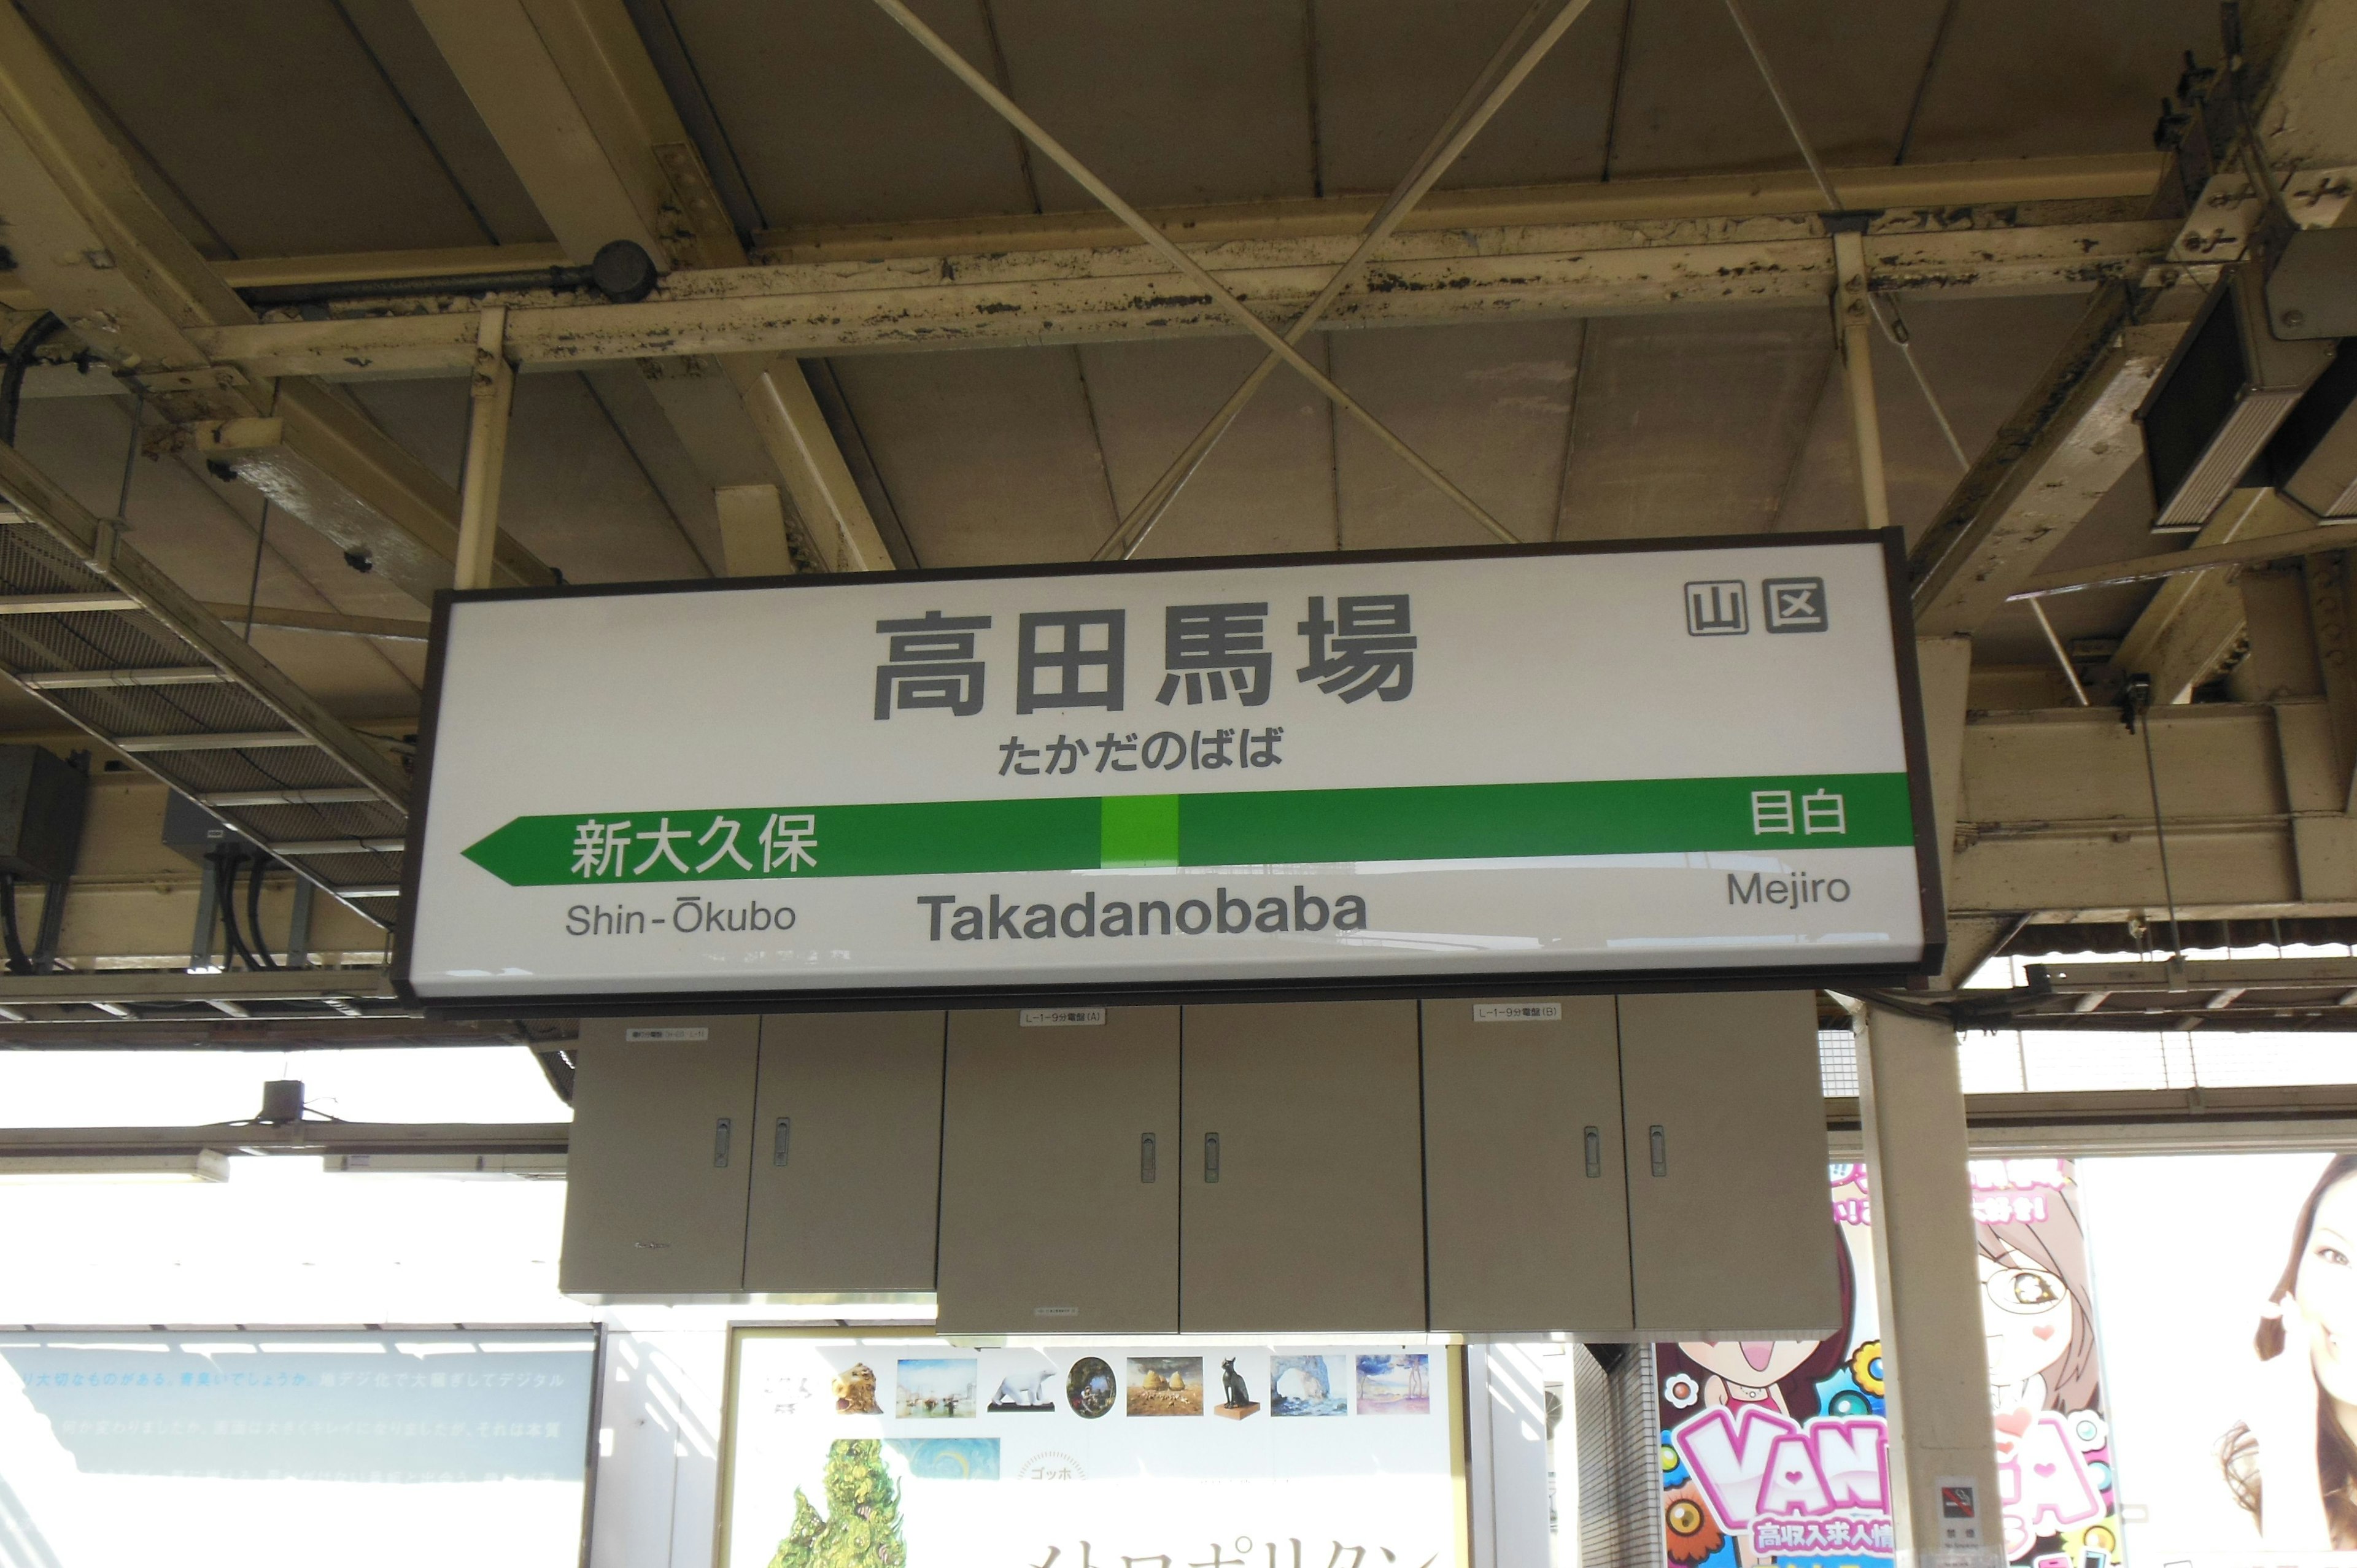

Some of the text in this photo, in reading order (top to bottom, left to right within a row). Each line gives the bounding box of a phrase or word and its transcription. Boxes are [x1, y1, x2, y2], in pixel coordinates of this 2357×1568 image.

[1690, 581, 1823, 633] 山 区
[873, 594, 1417, 720] 高田馬場
[998, 727, 1284, 776] たかだのばば
[1751, 789, 1846, 835] 目白
[571, 813, 818, 878] 新大久保
[917, 885, 1367, 941] Takadanobaba
[1728, 871, 1851, 910] Mejiro
[565, 897, 796, 937] Shin-Ōkubo
[1031, 1467, 1072, 1481] ゴッホ
